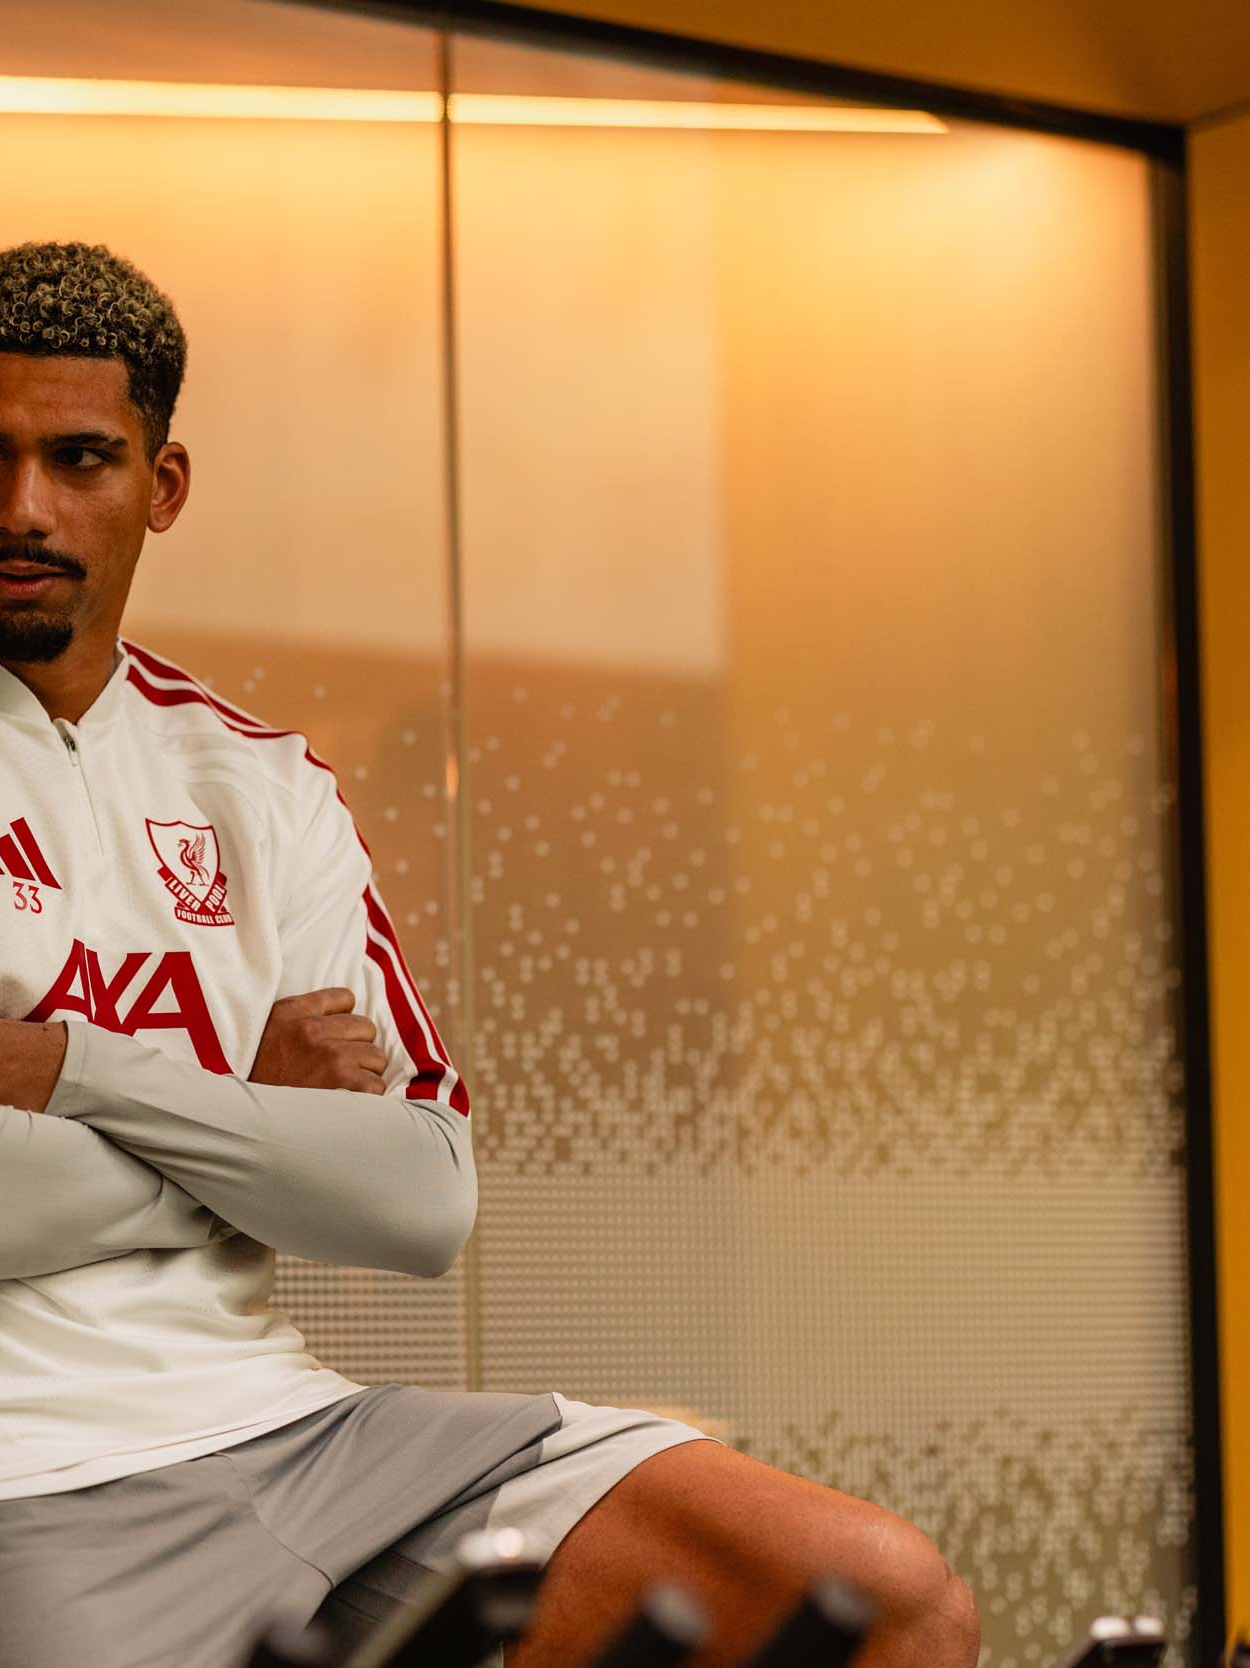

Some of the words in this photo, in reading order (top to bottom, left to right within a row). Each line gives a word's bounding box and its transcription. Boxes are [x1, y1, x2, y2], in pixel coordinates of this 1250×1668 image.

[12, 881, 43, 914] 33
[176, 909, 215, 924] FOOTBALL
[215, 913, 233, 924] CLUB
